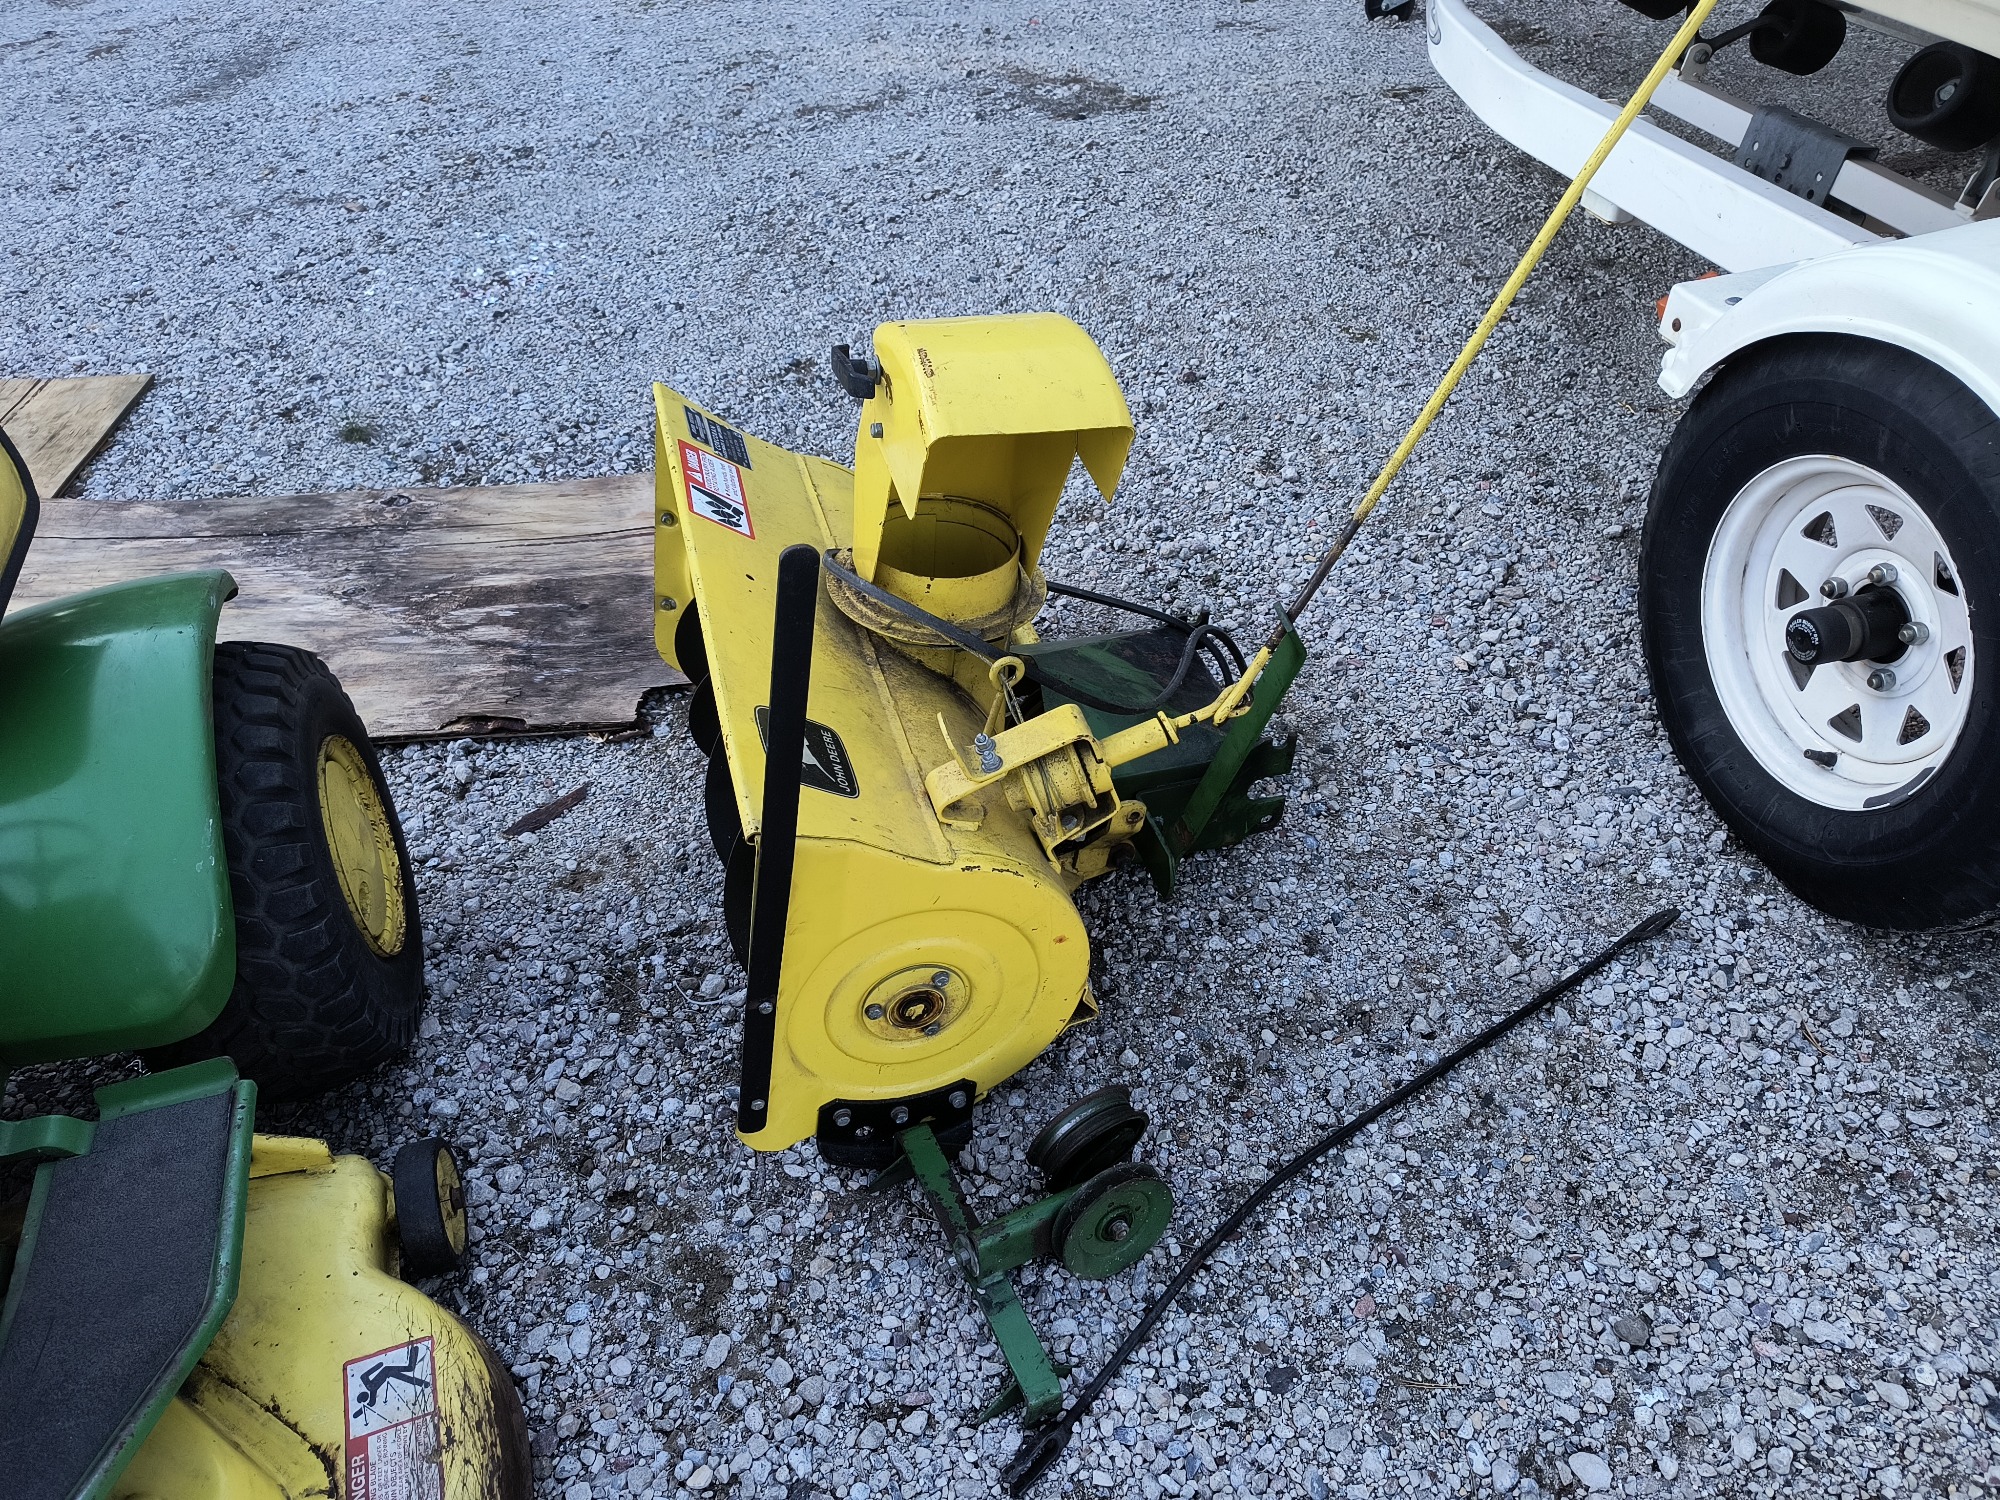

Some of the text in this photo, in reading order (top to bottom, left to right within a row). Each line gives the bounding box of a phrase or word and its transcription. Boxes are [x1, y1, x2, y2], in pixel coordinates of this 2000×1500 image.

[821, 729, 850, 792] JOHN DEERE
[389, 1452, 397, 1487] OBJECTS
